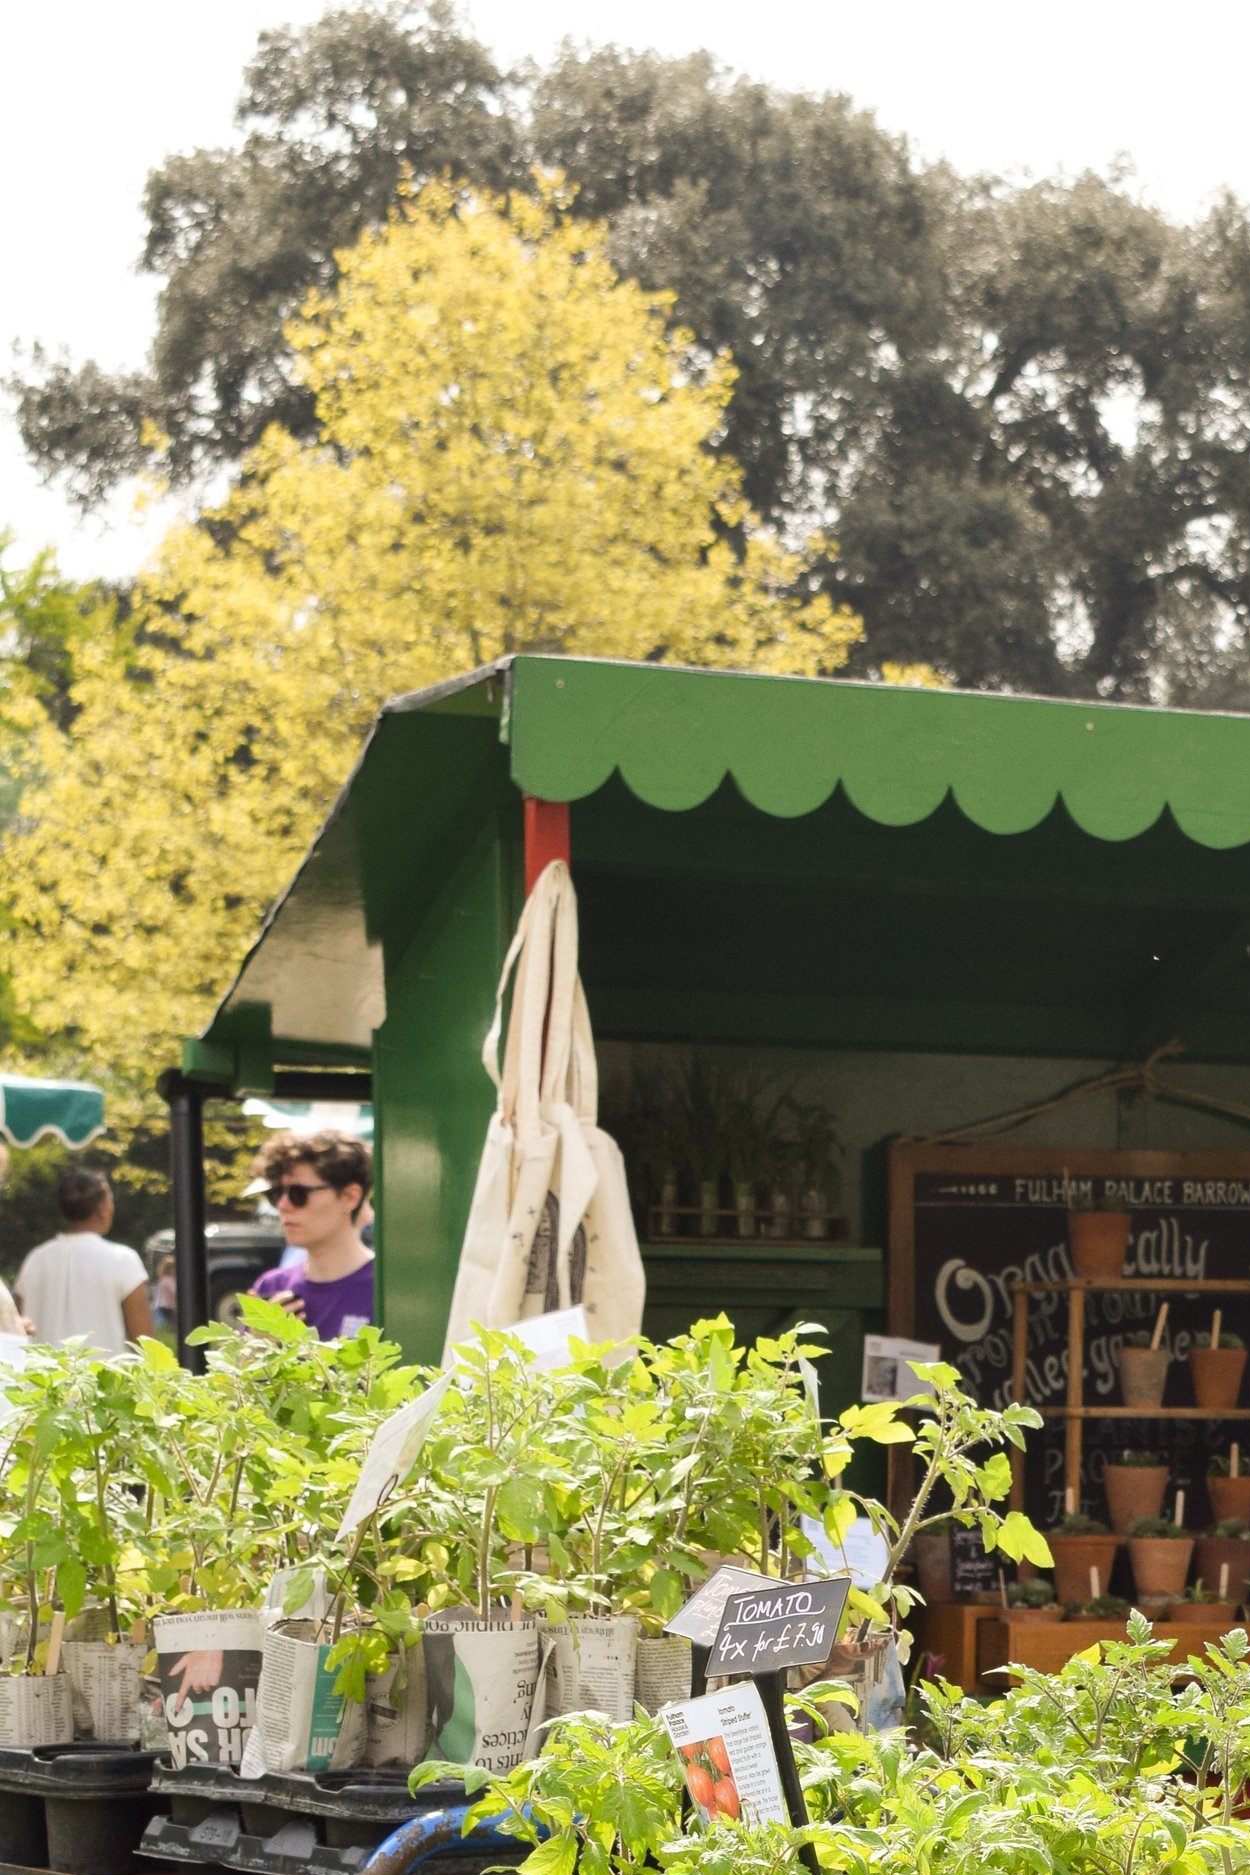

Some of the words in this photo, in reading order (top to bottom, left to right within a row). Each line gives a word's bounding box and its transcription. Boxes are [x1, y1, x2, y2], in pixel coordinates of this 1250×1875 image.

[1014, 1178, 1092, 1201] FULHAM
[1105, 1179, 1173, 1204] PALACE
[734, 1592, 812, 1624] TOMATO
[719, 1633, 747, 1661] 4x
[752, 1631, 774, 1662] for
